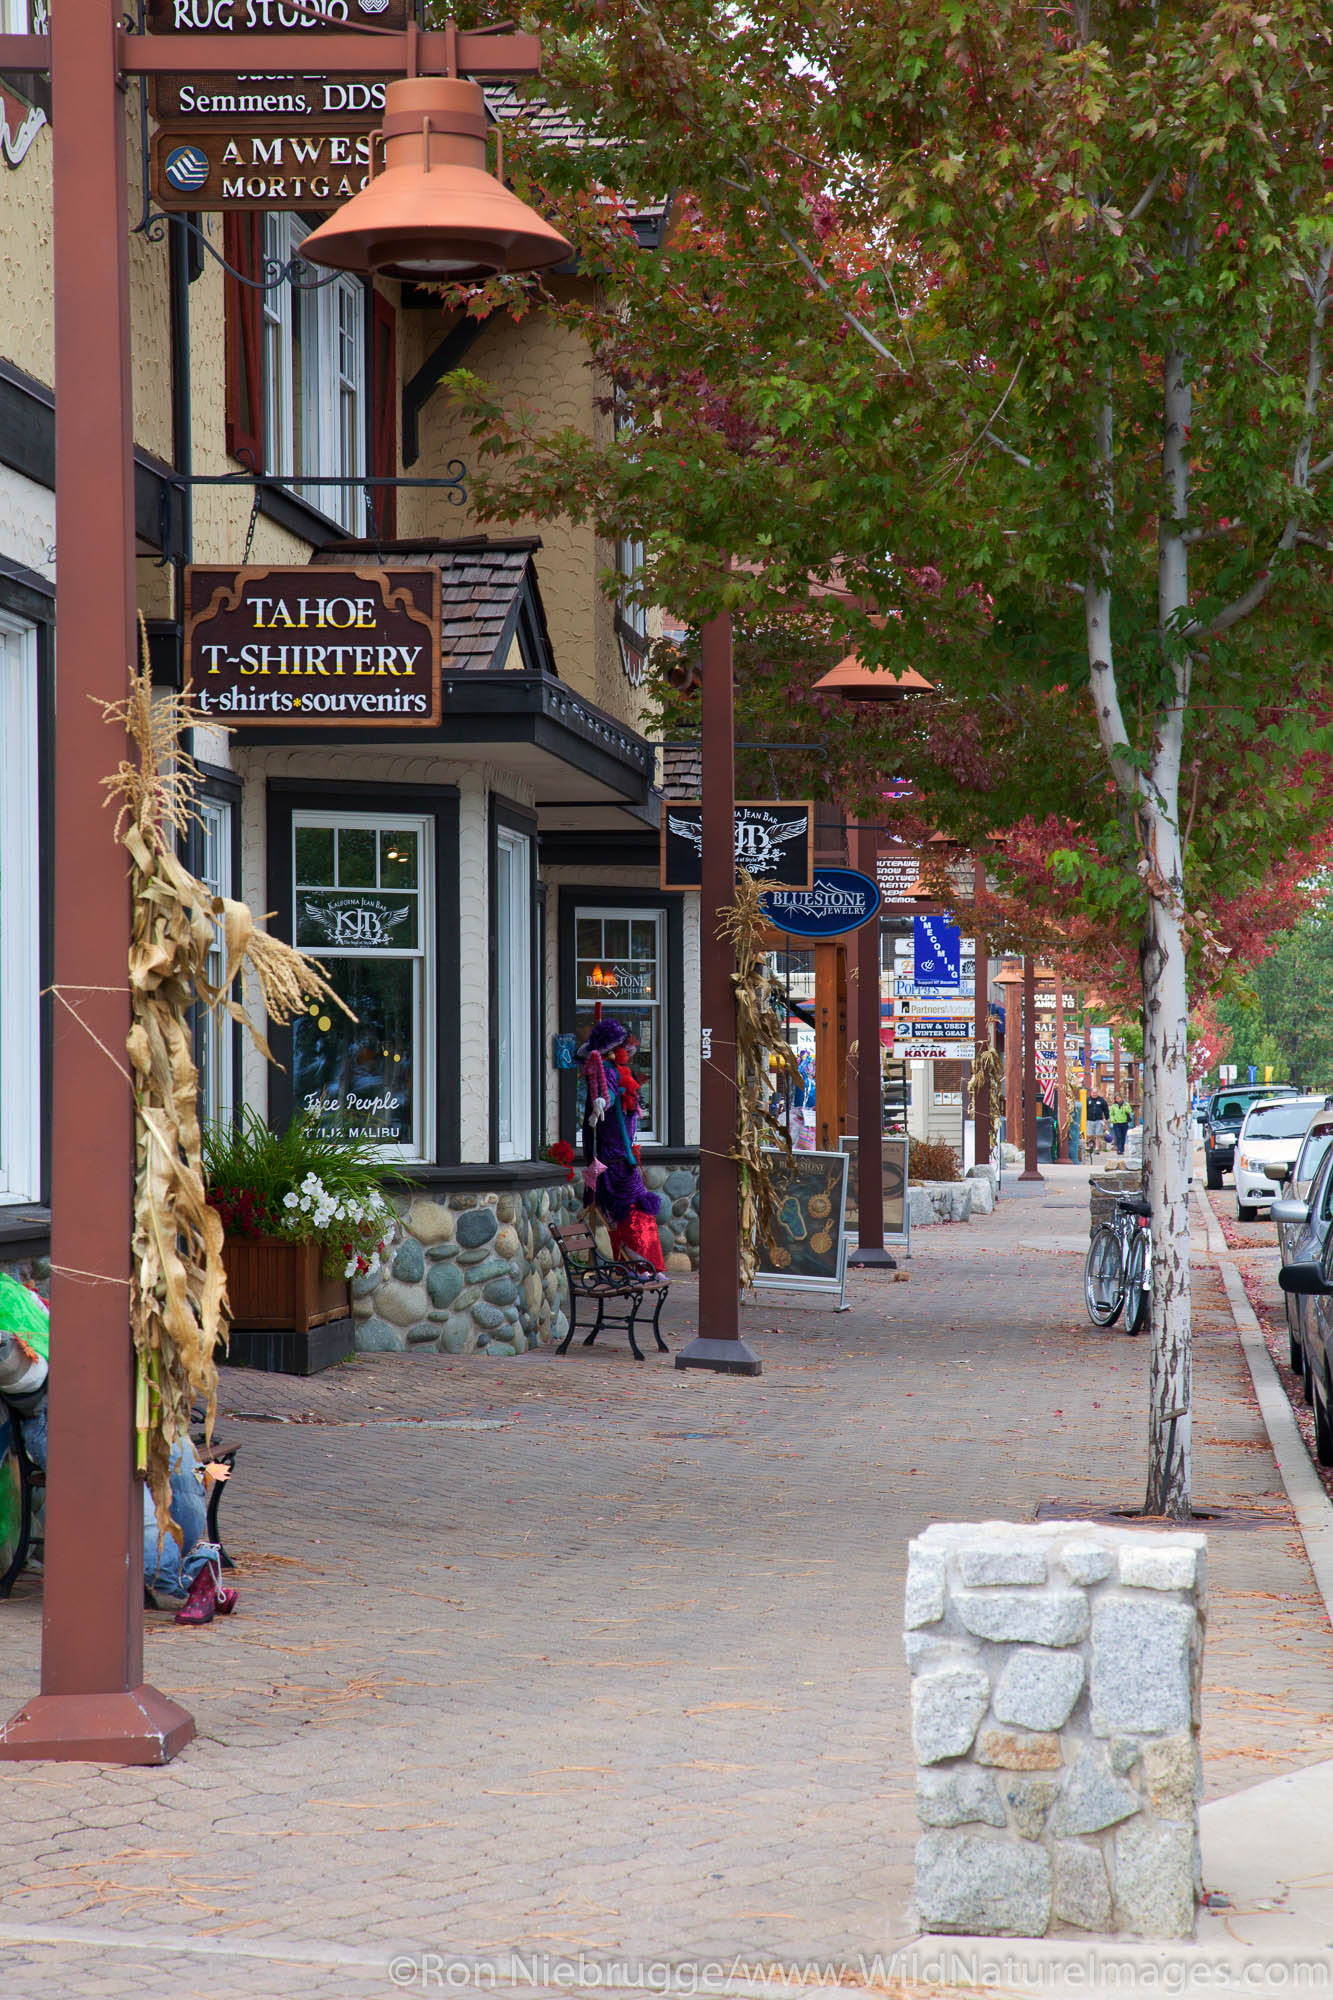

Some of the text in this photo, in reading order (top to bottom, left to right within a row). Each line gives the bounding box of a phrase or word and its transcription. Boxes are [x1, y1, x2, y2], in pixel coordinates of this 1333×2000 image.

[174, 0, 349, 30] RUG STUDIO
[179, 83, 386, 114] Semmens, DDS
[246, 597, 376, 629] TAHOE
[201, 644, 423, 676] T-SHIRTERY
[199, 684, 427, 712] t-shirts souvenirs
[734, 821, 769, 852] JB
[772, 892, 866, 907] BLUESTONE
[820, 906, 866, 916] JEWELRY
[336, 908, 381, 936] KJB
[1034, 1023, 1067, 1031] SALS
[1034, 1041, 1076, 1050] ENTLS
[303, 1091, 400, 1115] Free People
[348, 1127, 400, 1138] MALIBU
